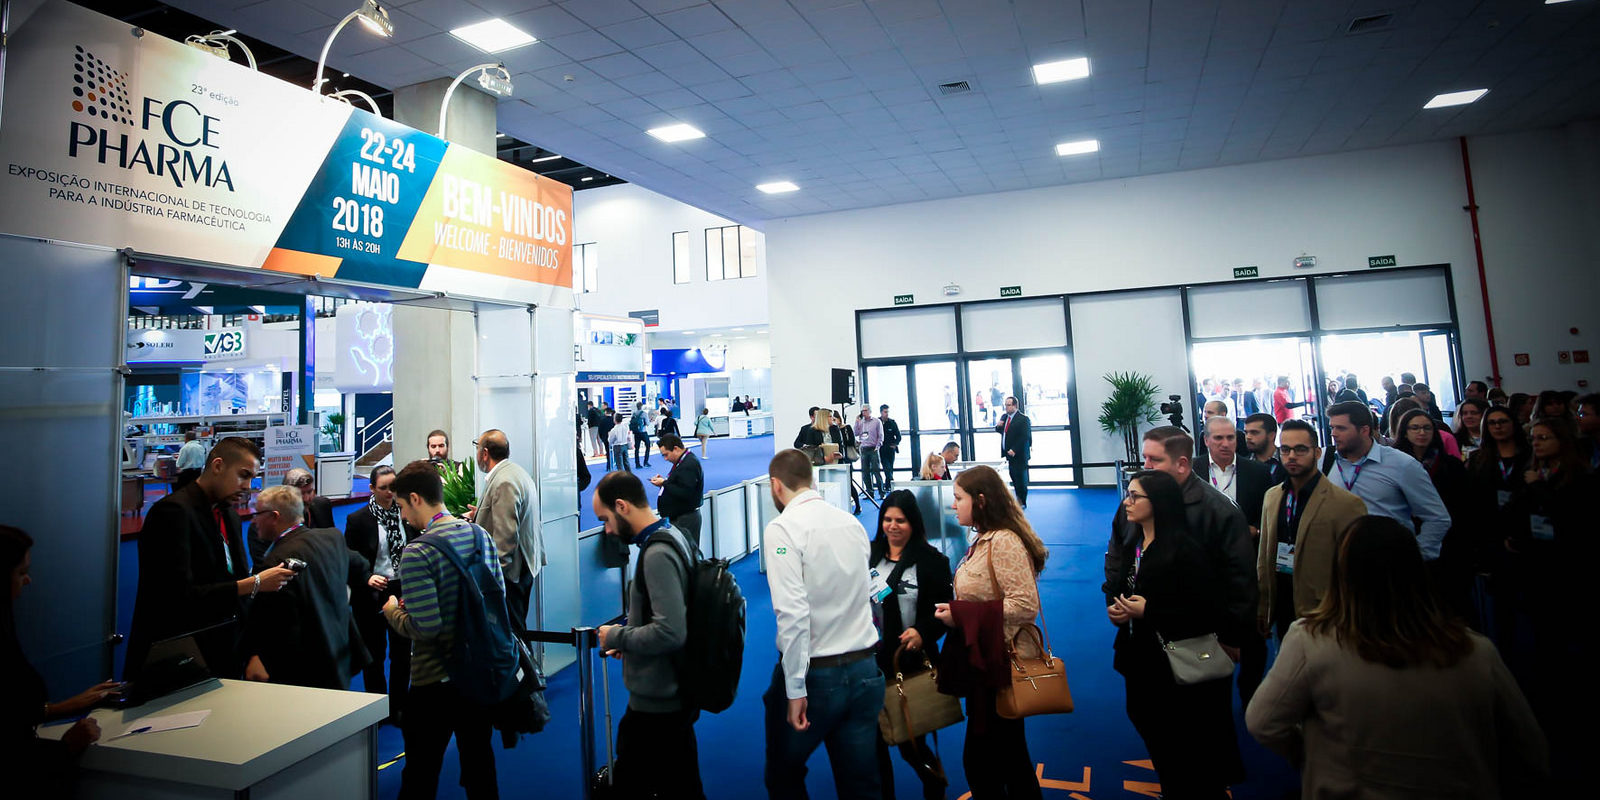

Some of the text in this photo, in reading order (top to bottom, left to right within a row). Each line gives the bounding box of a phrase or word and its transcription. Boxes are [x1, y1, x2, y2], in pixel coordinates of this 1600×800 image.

[209, 90, 239, 107] edição
[142, 96, 221, 149] FCE
[68, 121, 235, 192] PHARMA
[361, 127, 416, 174] 22-24
[8, 163, 272, 224] EXPOSIÇÃO INTERNACIONAL DE TECNOLOGIA
[352, 162, 399, 205] MAIO
[49, 188, 246, 231] PARA A INDÚSTRIA FARMACÊUTICA
[332, 196, 384, 238] 2018
[442, 174, 566, 246] BEM-VINDOS
[336, 236, 380, 254] 13H ÀS 20H
[434, 221, 490, 255] WELCOME
[499, 238, 559, 270] BIENVENIDOS
[1370, 258, 1395, 266] SAÍDA
[1001, 287, 1020, 297] SAÍDA
[1235, 268, 1257, 277] SAÍDA
[895, 296, 913, 305] SAÍDA
